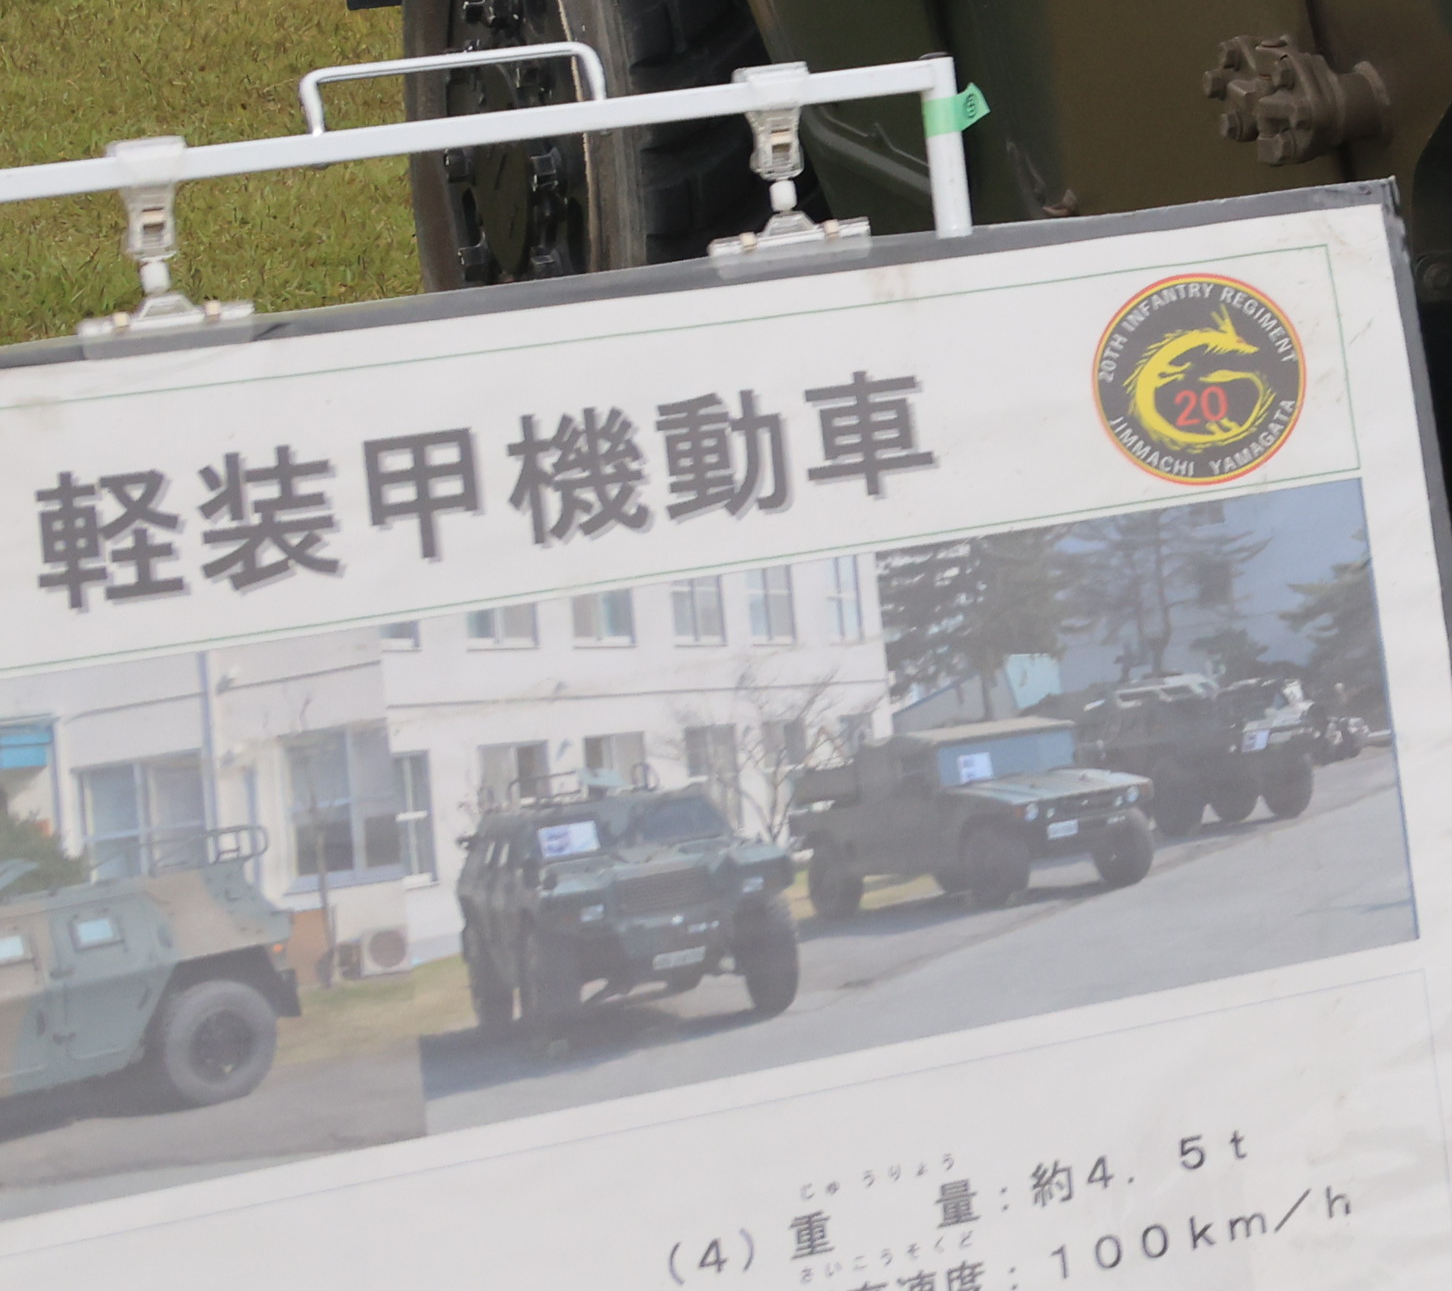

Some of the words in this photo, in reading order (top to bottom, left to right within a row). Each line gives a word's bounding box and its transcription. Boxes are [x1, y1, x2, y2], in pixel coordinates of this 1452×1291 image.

[1099, 331, 1128, 383] 20TH
[1120, 282, 1215, 333] INFANTRY
[1219, 286, 1298, 362] REGIMENT
[1108, 415, 1195, 477] JIMMACHI
[1208, 398, 1297, 476] YAMAGATA
[1173, 385, 1229, 427] 20
[35, 369, 937, 612] 軽装甲機動車
